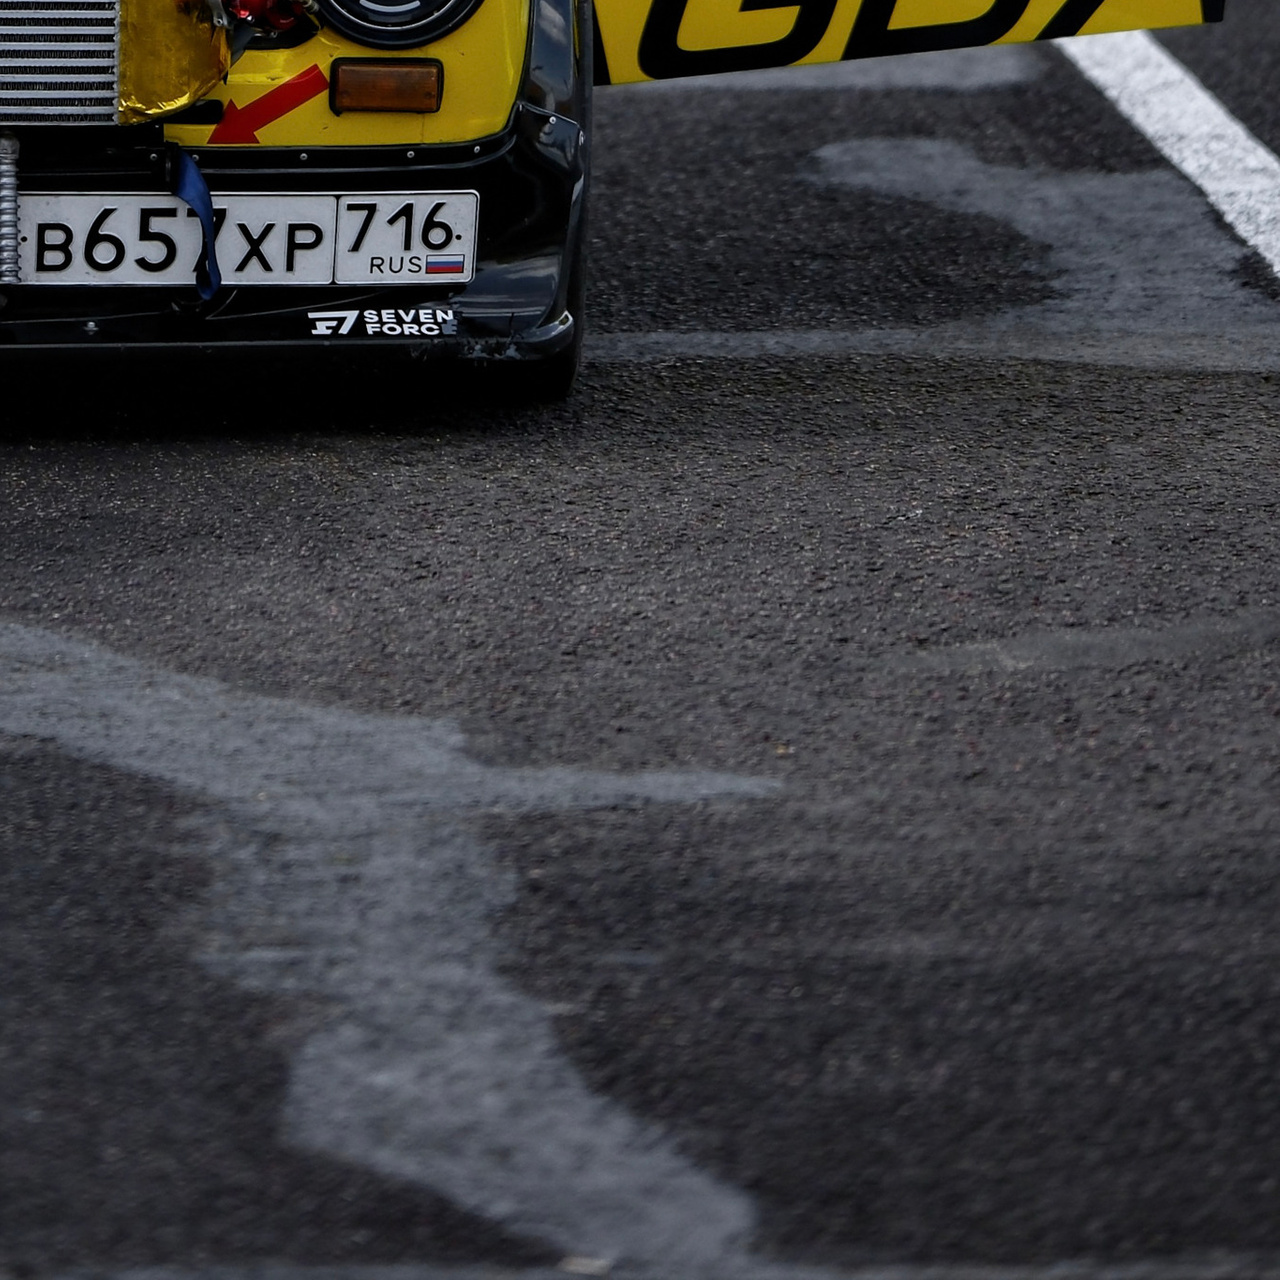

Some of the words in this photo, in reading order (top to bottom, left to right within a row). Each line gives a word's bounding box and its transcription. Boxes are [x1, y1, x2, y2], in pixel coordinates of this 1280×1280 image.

[346, 201, 454, 252] 716
[369, 255, 422, 274] RUS
[363, 309, 454, 323] SEVEN
[365, 323, 458, 335] FORCE
